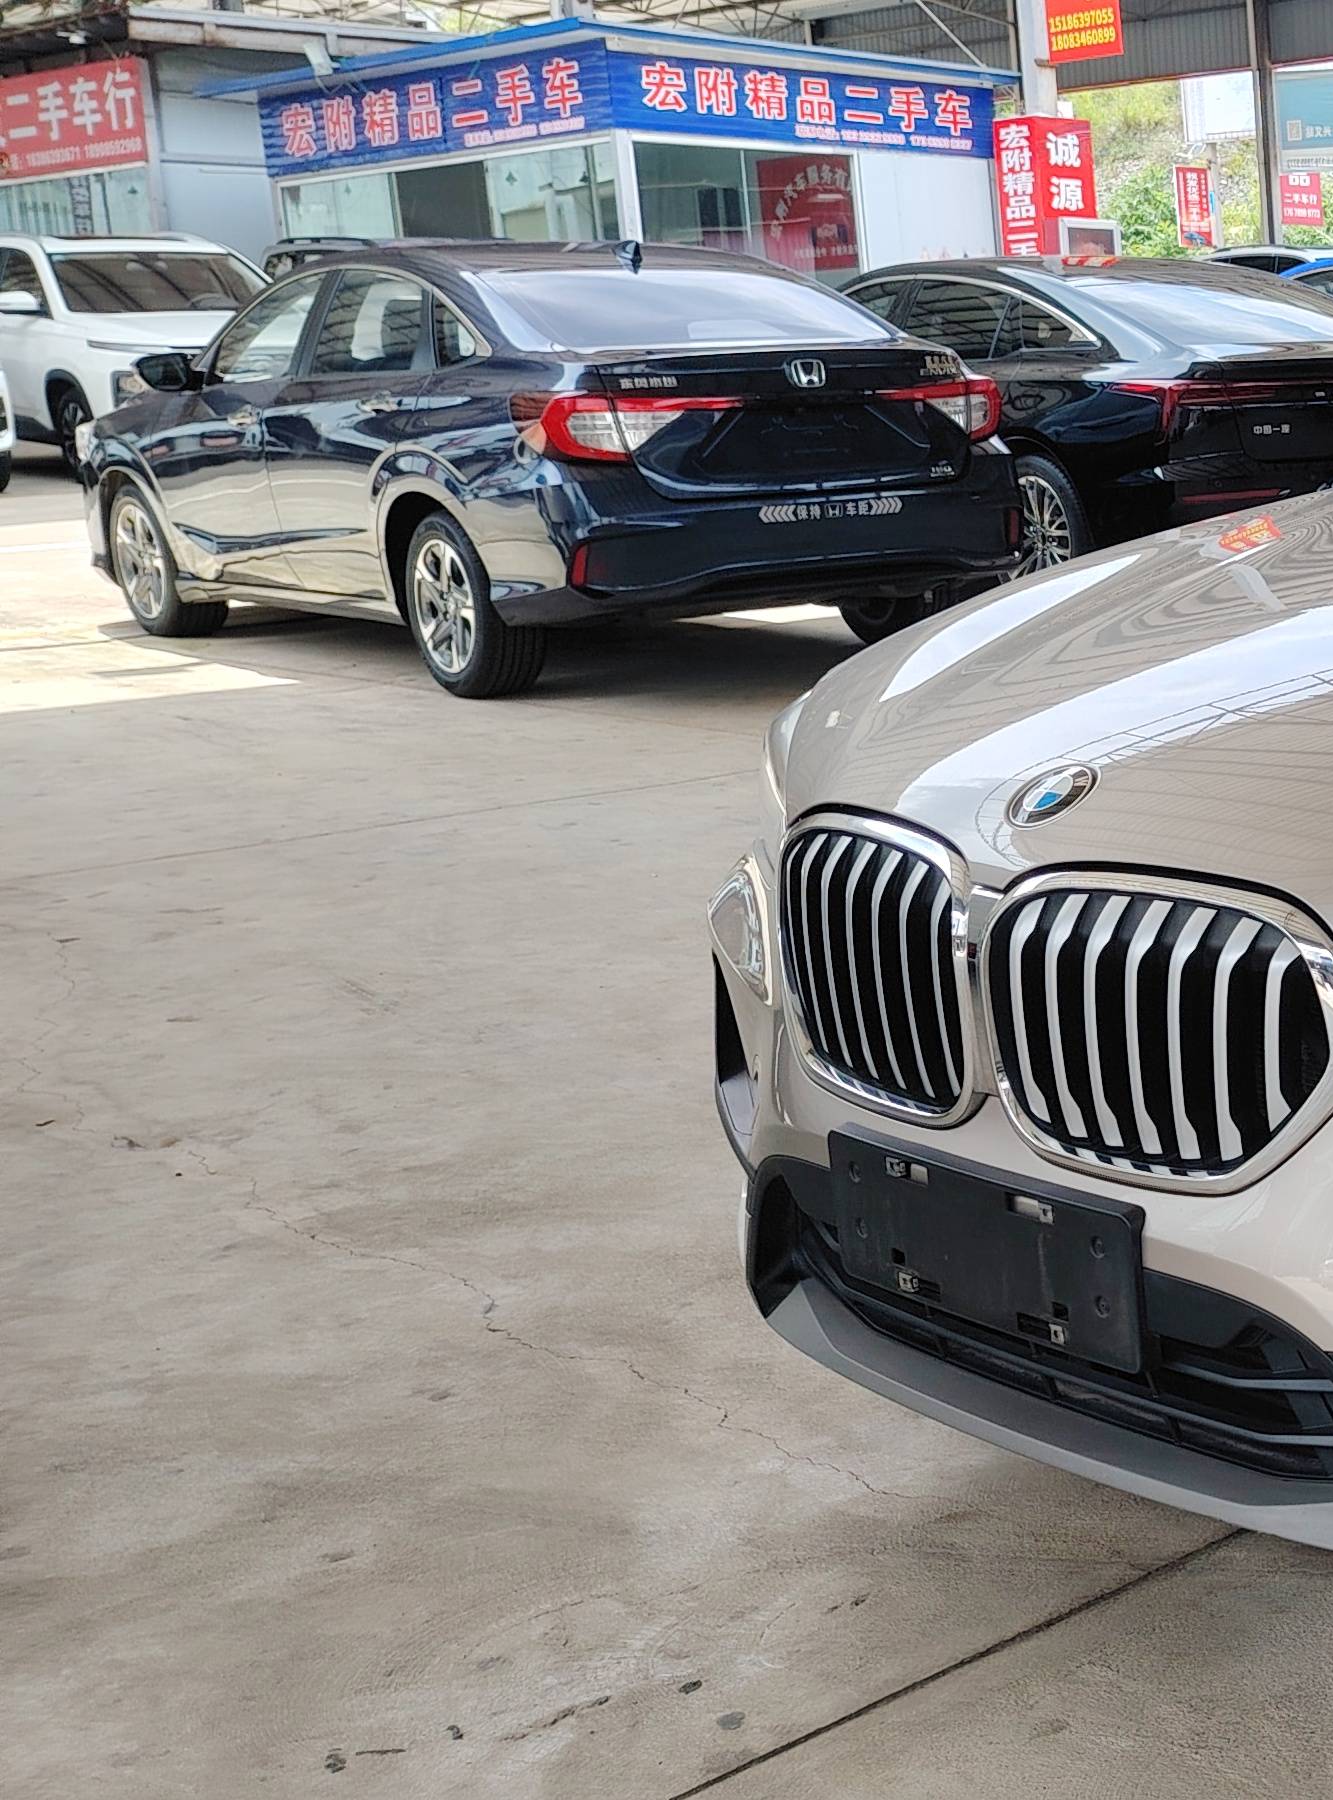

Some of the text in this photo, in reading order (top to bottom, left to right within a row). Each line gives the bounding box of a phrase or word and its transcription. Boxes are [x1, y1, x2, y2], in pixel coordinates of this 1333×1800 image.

[0, 71, 137, 147] 二手车行
[280, 56, 583, 158] 宏附精品二手车
[640, 61, 974, 137] 宏附精品二手车
[1045, 131, 1085, 212] 诚源
[1253, 423, 1291, 435] 中国一汽
[796, 503, 822, 520] 保持
[845, 501, 871, 517] 车距
